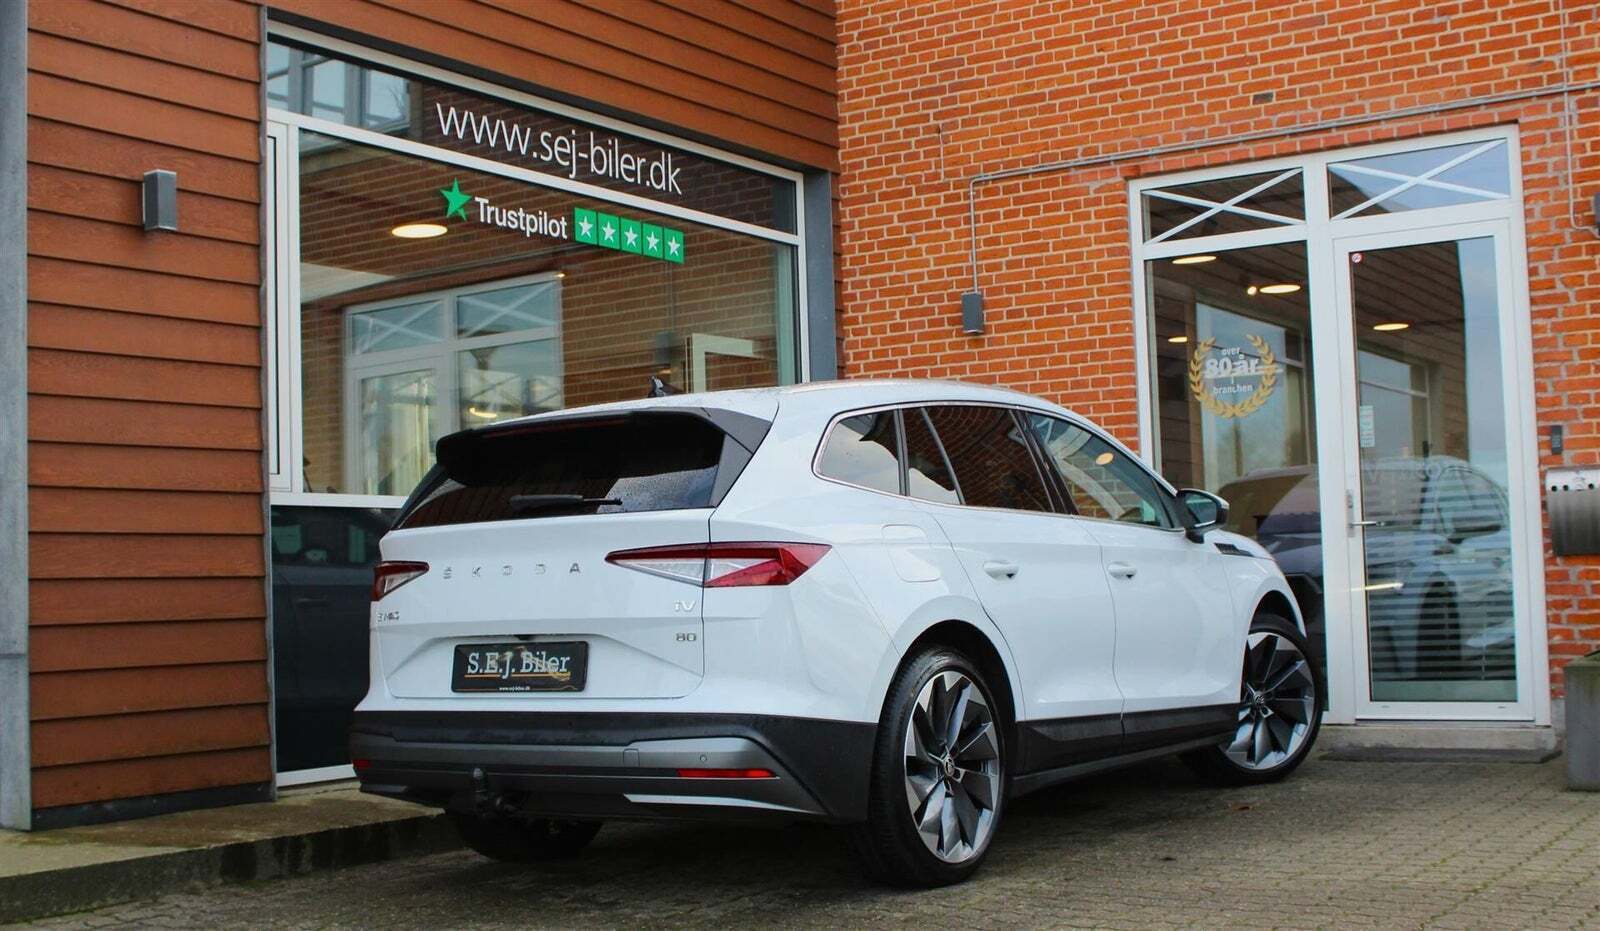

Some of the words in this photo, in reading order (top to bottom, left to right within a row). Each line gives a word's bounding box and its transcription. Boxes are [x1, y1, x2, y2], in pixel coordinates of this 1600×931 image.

[436, 103, 682, 195] www.sej-biler.dk
[475, 197, 567, 239] Trustpilot
[1221, 347, 1240, 356] over
[1204, 357, 1232, 379] 80
[1238, 354, 1259, 376] år
[1212, 384, 1254, 395] branchen
[674, 599, 696, 612] iV
[676, 632, 696, 641] 80
[467, 652, 515, 679] S.E.J.
[520, 651, 570, 673] Biler
